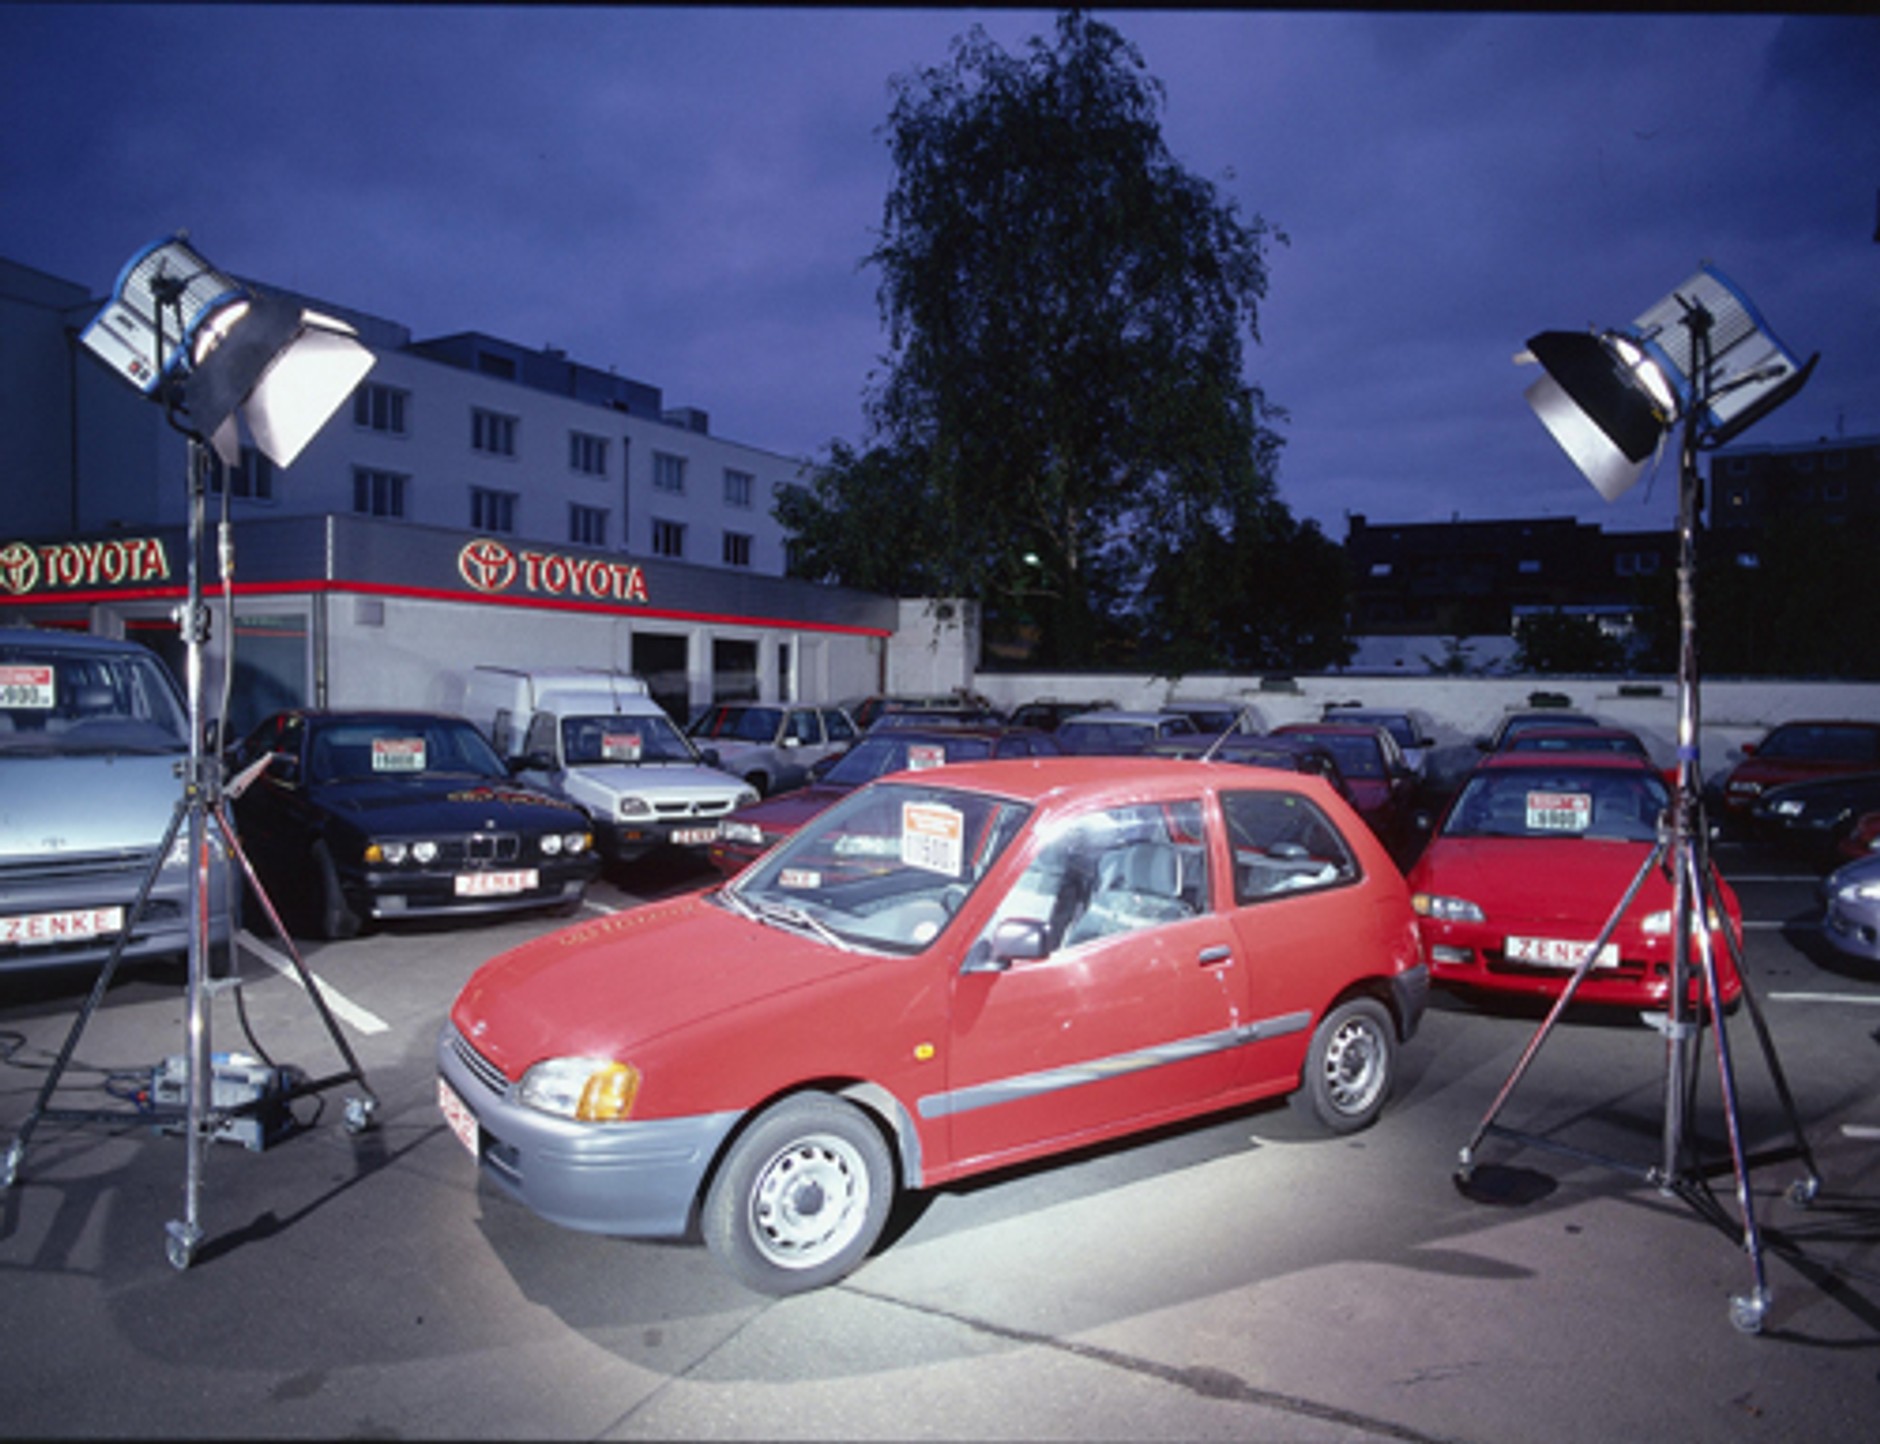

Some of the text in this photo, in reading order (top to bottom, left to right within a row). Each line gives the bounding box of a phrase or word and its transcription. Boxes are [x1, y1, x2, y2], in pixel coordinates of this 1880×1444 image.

[38, 538, 170, 586] TOYOTA
[519, 551, 649, 602] TOYOTA
[5, 909, 108, 941] ZENKE
[1519, 939, 1606, 965] ZENK
